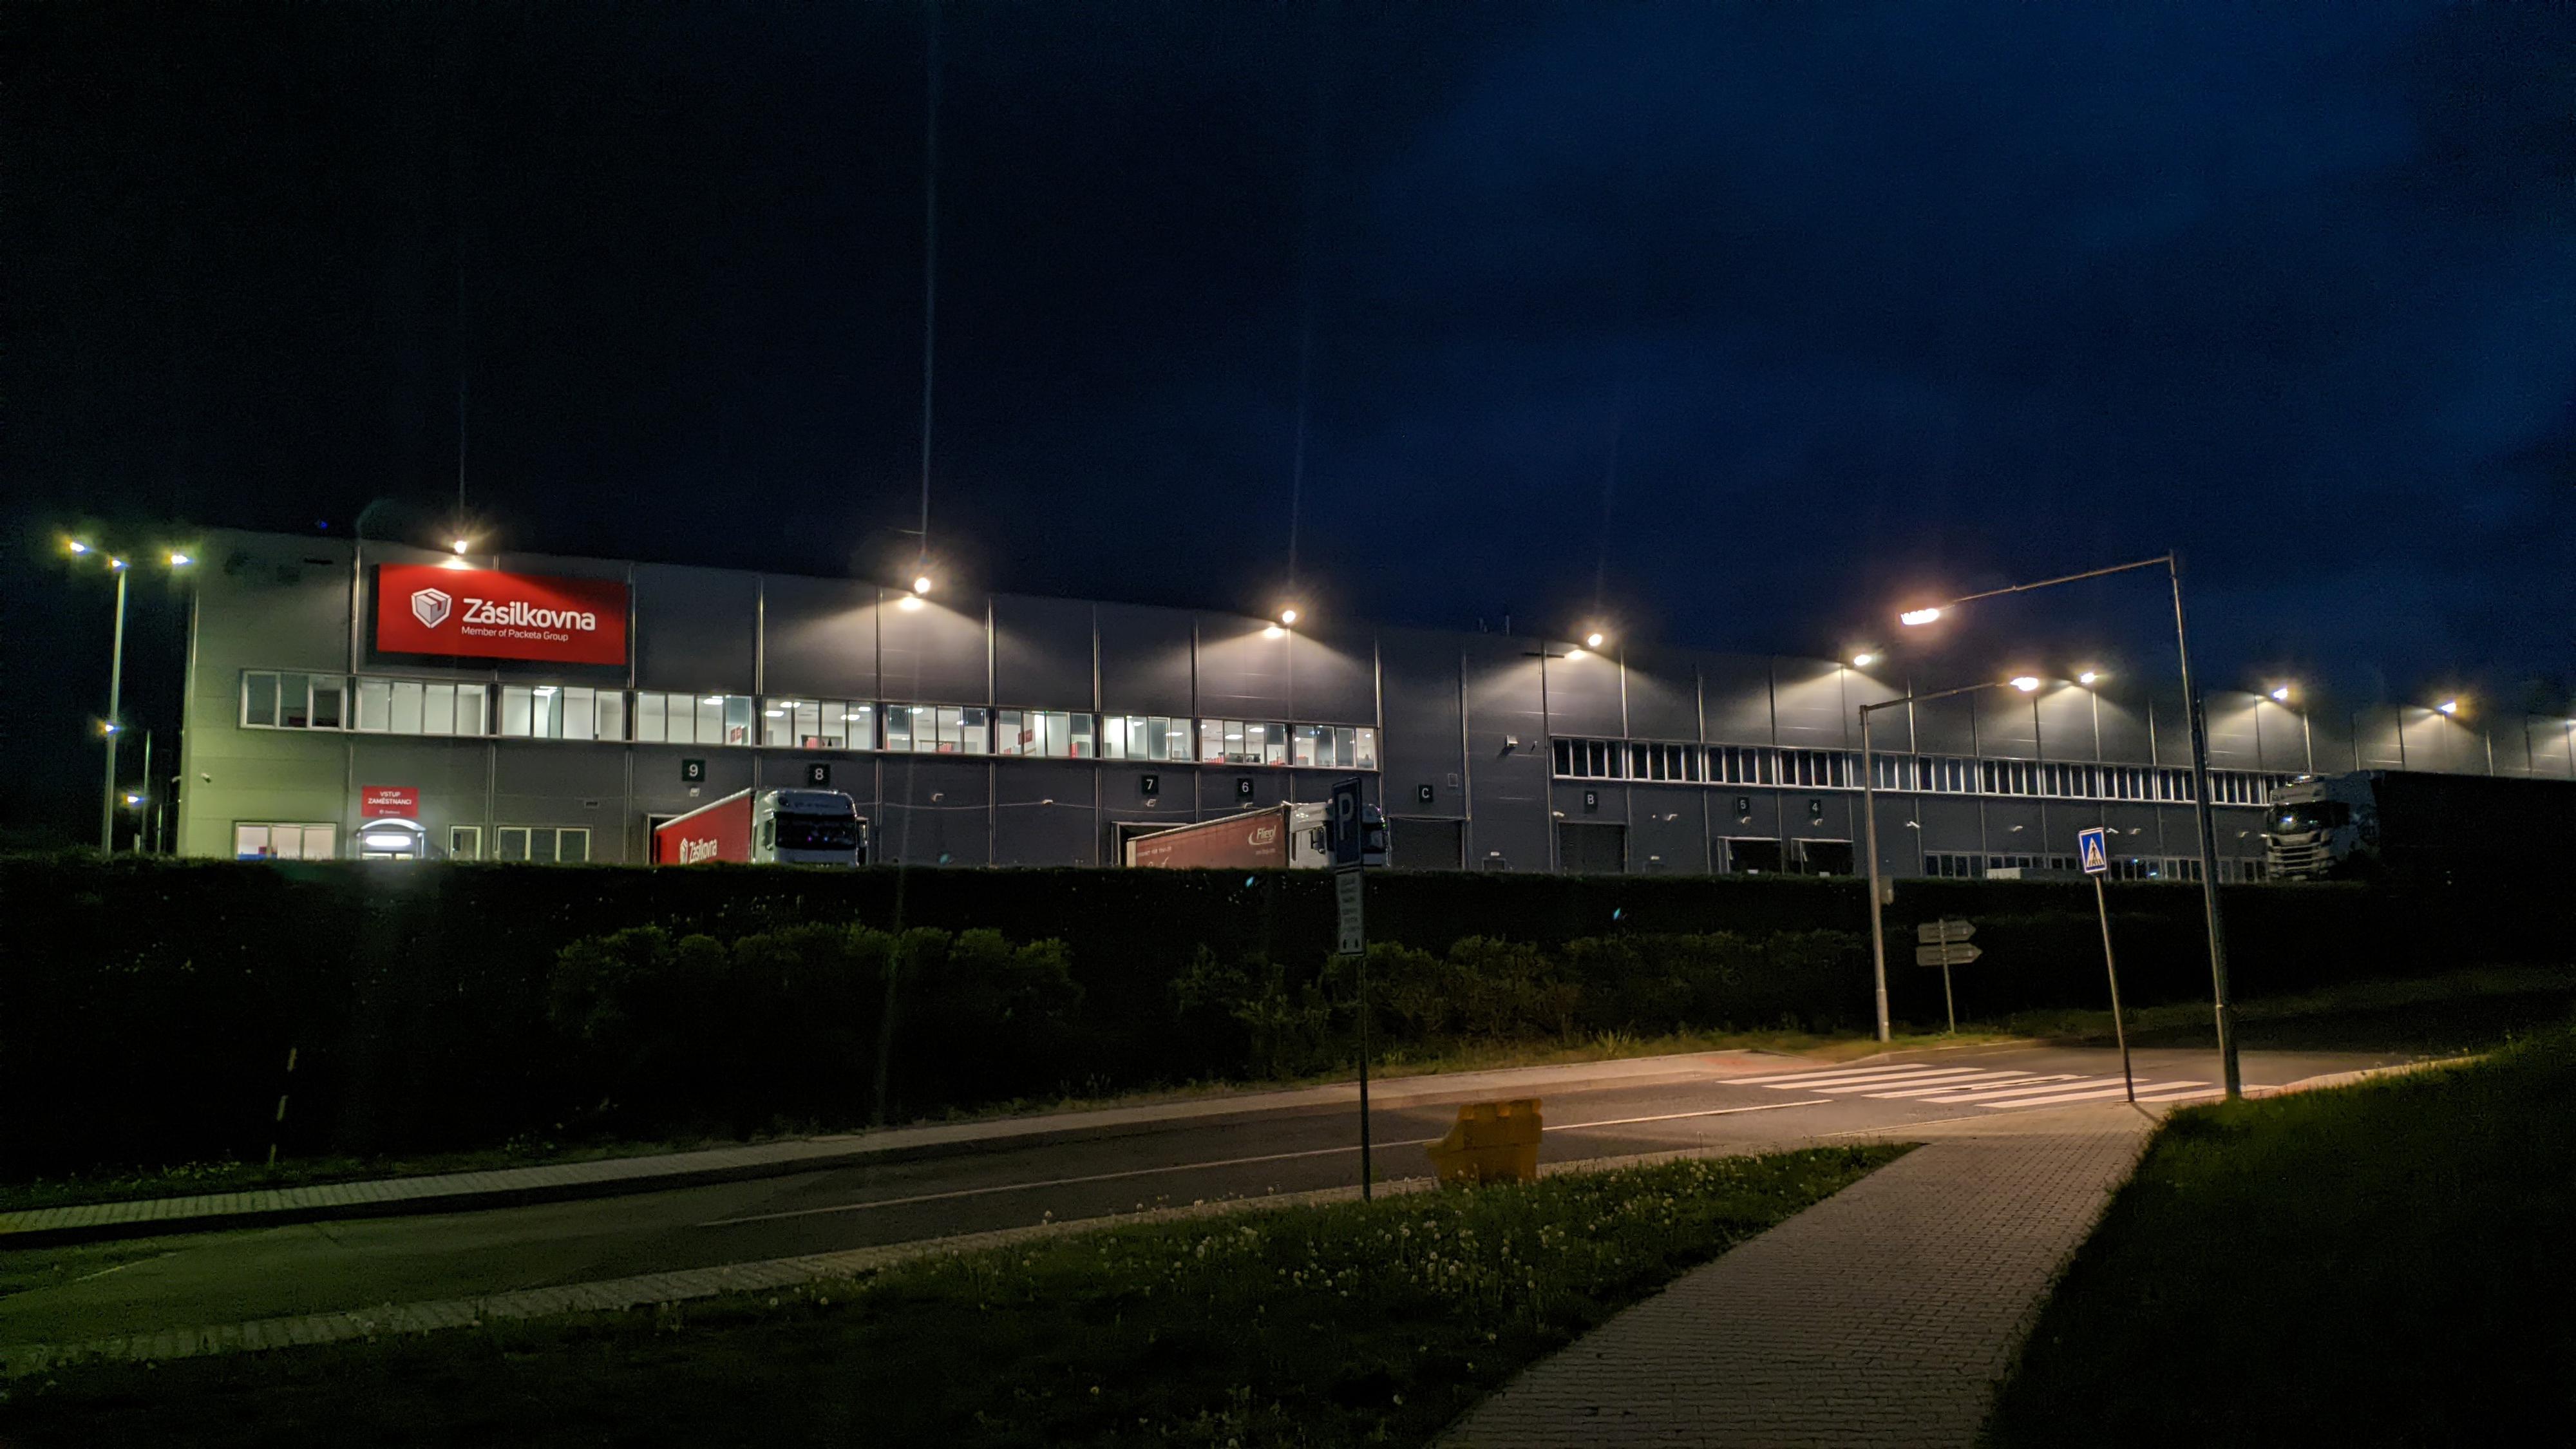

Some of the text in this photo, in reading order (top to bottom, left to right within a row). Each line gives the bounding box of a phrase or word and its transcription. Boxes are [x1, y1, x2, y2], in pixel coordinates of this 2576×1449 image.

[462, 598, 596, 631] Zásilkovna
[462, 626, 569, 642] Member of Packeta Group
[689, 764, 698, 776] 9
[815, 768, 824, 781] 8
[1146, 779, 1154, 790] 7
[1242, 782, 1249, 793] 6
[1421, 788, 1429, 799] C
[1587, 793, 1595, 805] B
[1740, 799, 1747, 810] 5
[1812, 801, 1819, 813] 4
[1339, 793, 1352, 840] P
[689, 838, 717, 864] Zásilkovna
